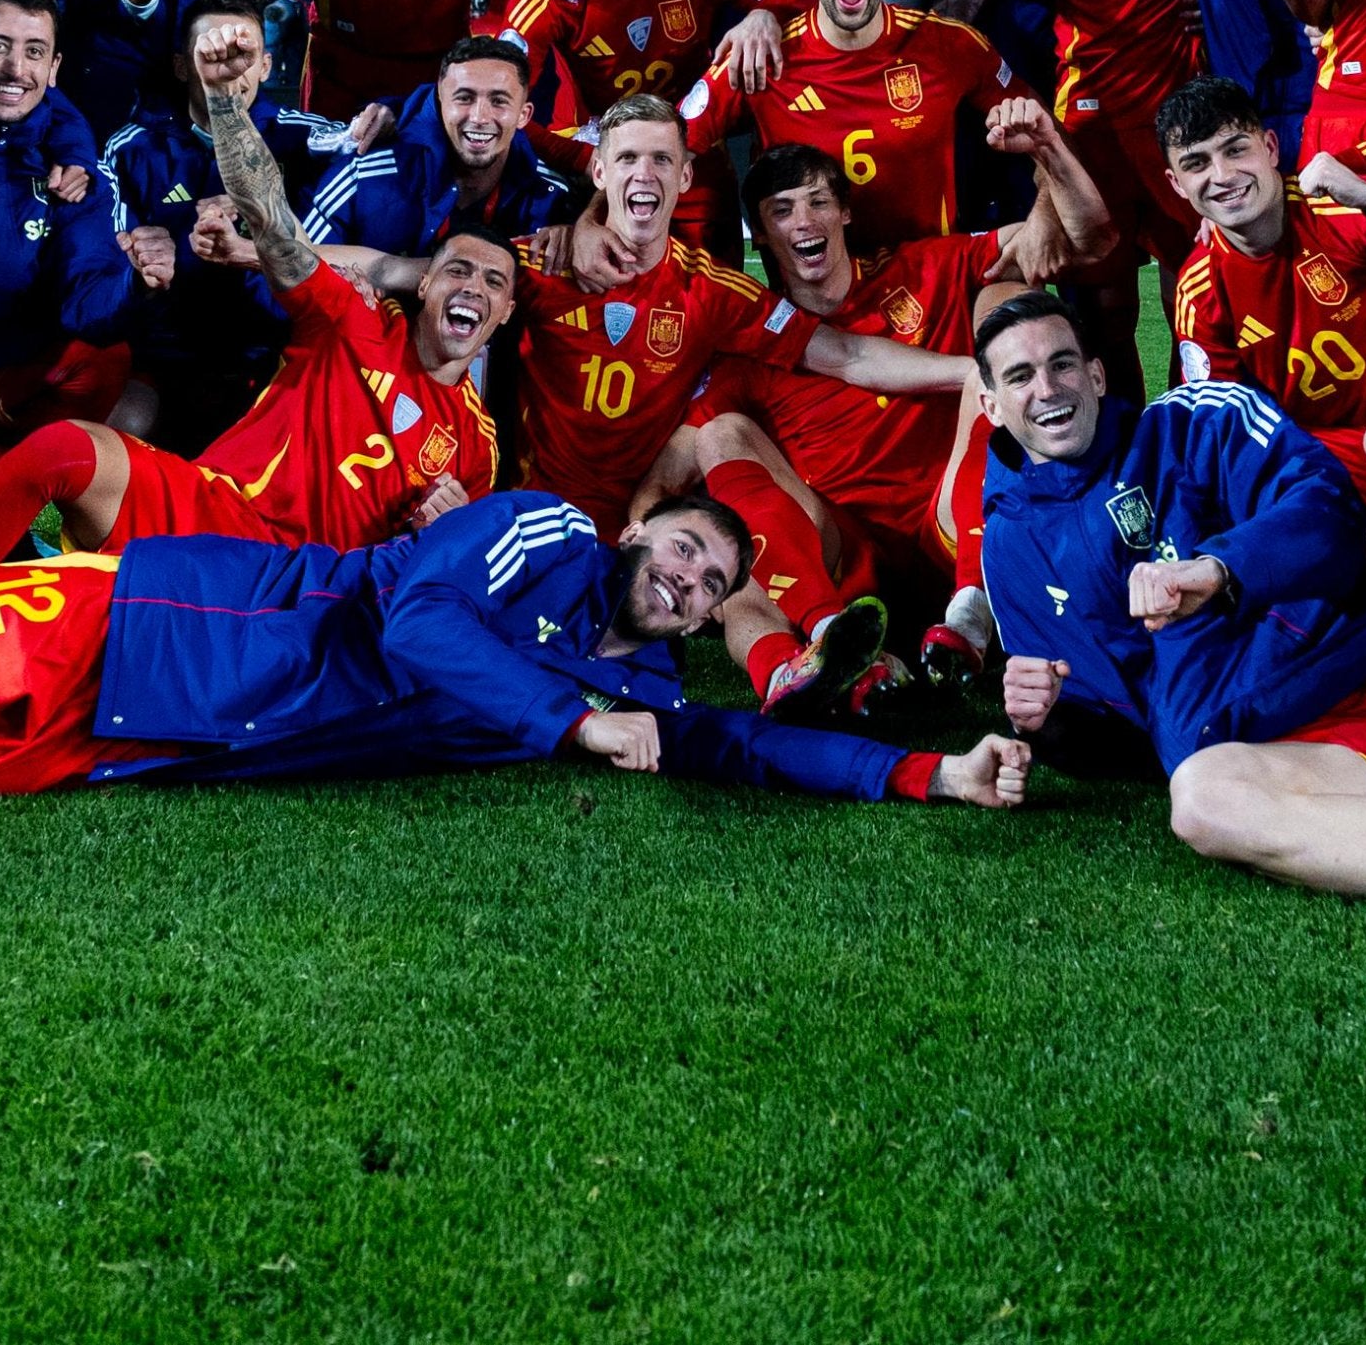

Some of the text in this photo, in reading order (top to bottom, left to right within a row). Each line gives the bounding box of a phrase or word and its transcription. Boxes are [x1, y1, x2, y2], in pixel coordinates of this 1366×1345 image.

[614, 60, 675, 99] 22
[843, 129, 877, 185] 6
[580, 354, 636, 419] 10
[1287, 330, 1366, 401] 20
[337, 433, 395, 490] 2
